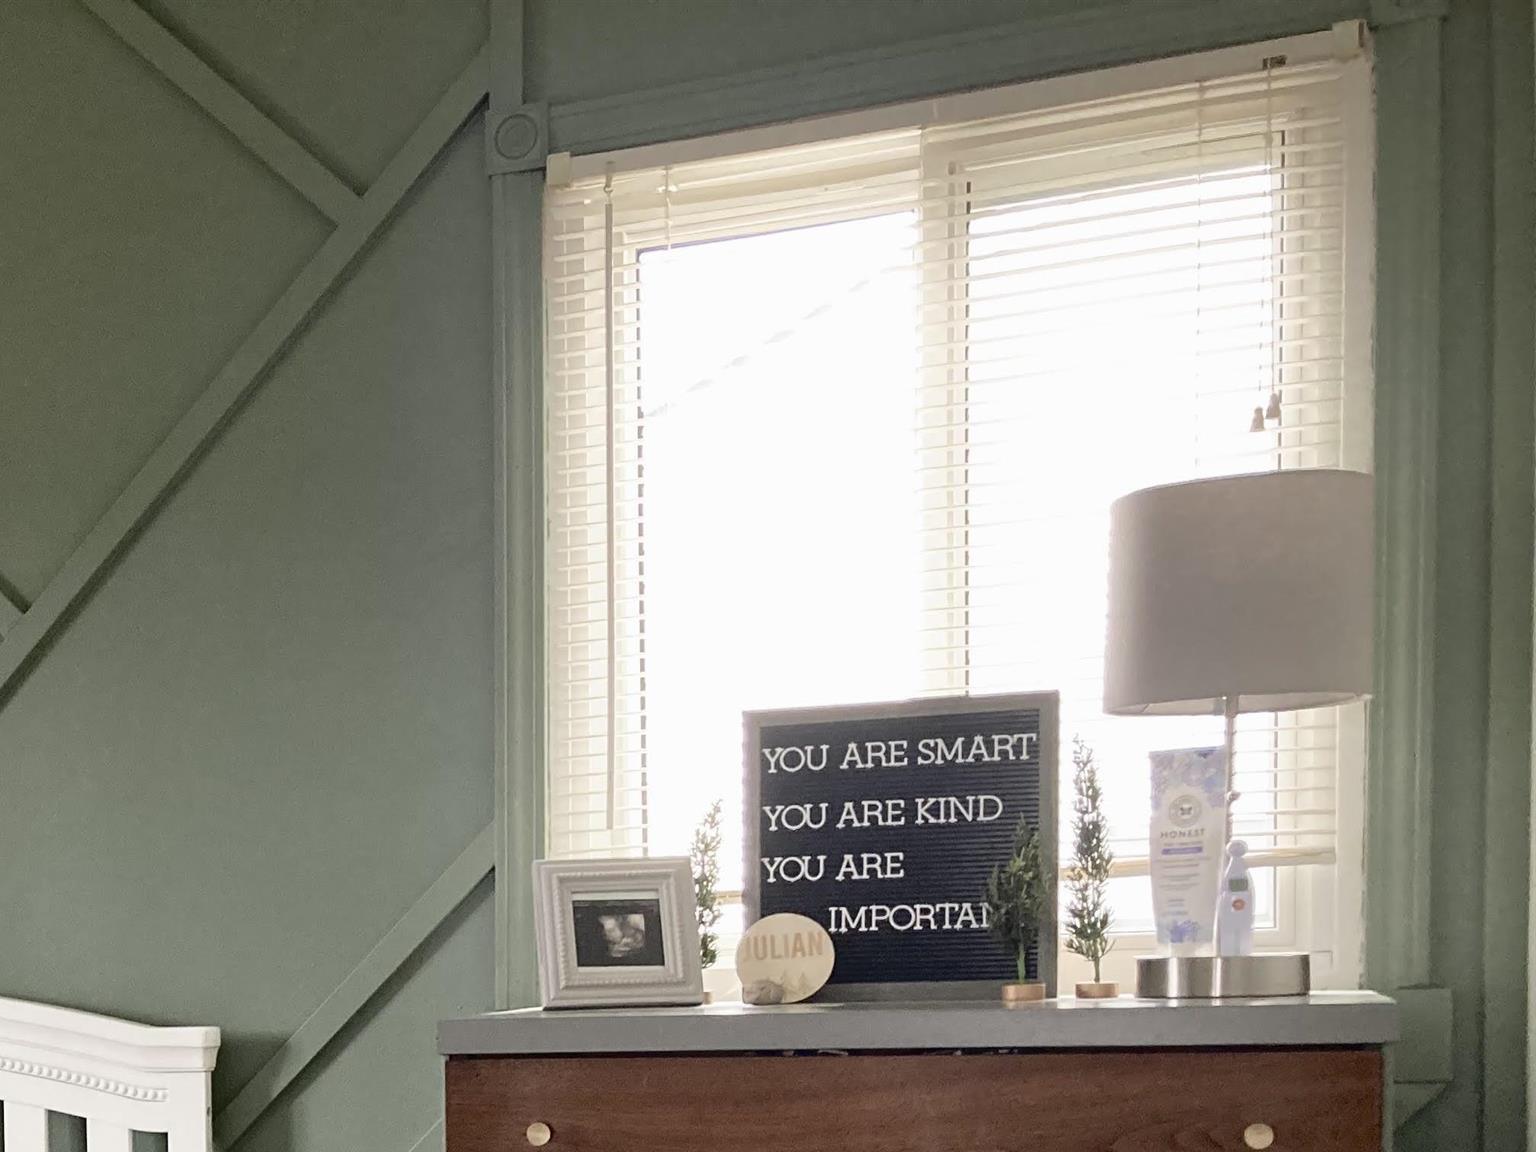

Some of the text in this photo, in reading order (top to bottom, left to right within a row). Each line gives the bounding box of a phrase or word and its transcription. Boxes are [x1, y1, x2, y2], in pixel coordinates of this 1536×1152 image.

[761, 732, 1037, 774] YOU ARE SMART
[762, 794, 1003, 832] YOU ARE KIND
[760, 851, 904, 883] YOU ARE
[828, 902, 995, 934] IMPORTA
